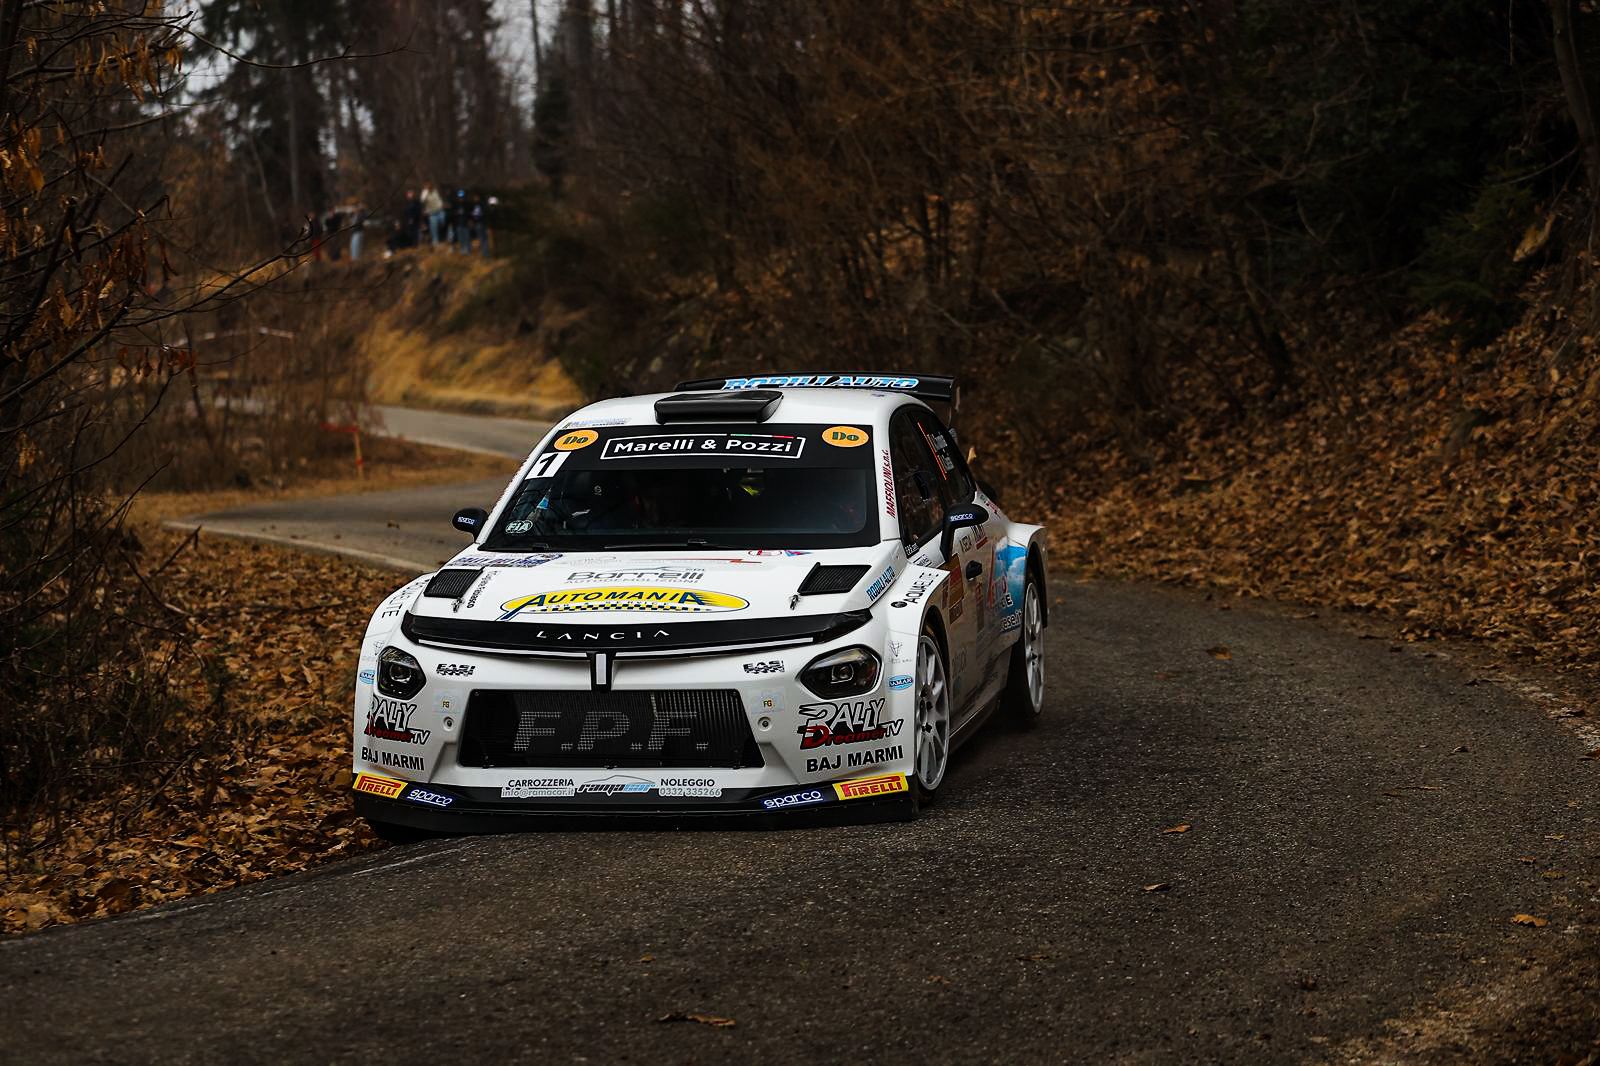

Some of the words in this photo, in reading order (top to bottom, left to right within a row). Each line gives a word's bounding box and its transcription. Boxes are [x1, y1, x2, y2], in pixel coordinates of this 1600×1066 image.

[614, 439, 694, 453] Marelli
[701, 440, 717, 450] &
[725, 440, 793, 453] Pozzi
[536, 453, 559, 477] 1
[506, 522, 532, 533] FIA
[566, 572, 704, 580] Borrelli
[505, 591, 706, 612] AUTOMANIA
[536, 629, 670, 640] LANCIA
[798, 698, 885, 734] RALLY
[361, 746, 379, 764] BAJ
[382, 752, 425, 771] MARMI
[806, 754, 842, 773] BAJ
[847, 745, 904, 767] MARMI
[357, 775, 402, 797] PIRELLI
[508, 778, 575, 788] CARROZZERIA
[660, 778, 715, 787] NOLEGGIO
[660, 786, 683, 796] 0332
[685, 787, 721, 797] 335266
[840, 775, 903, 797] PIRELLI
[410, 789, 453, 806] sparco
[764, 789, 822, 808] sparco
